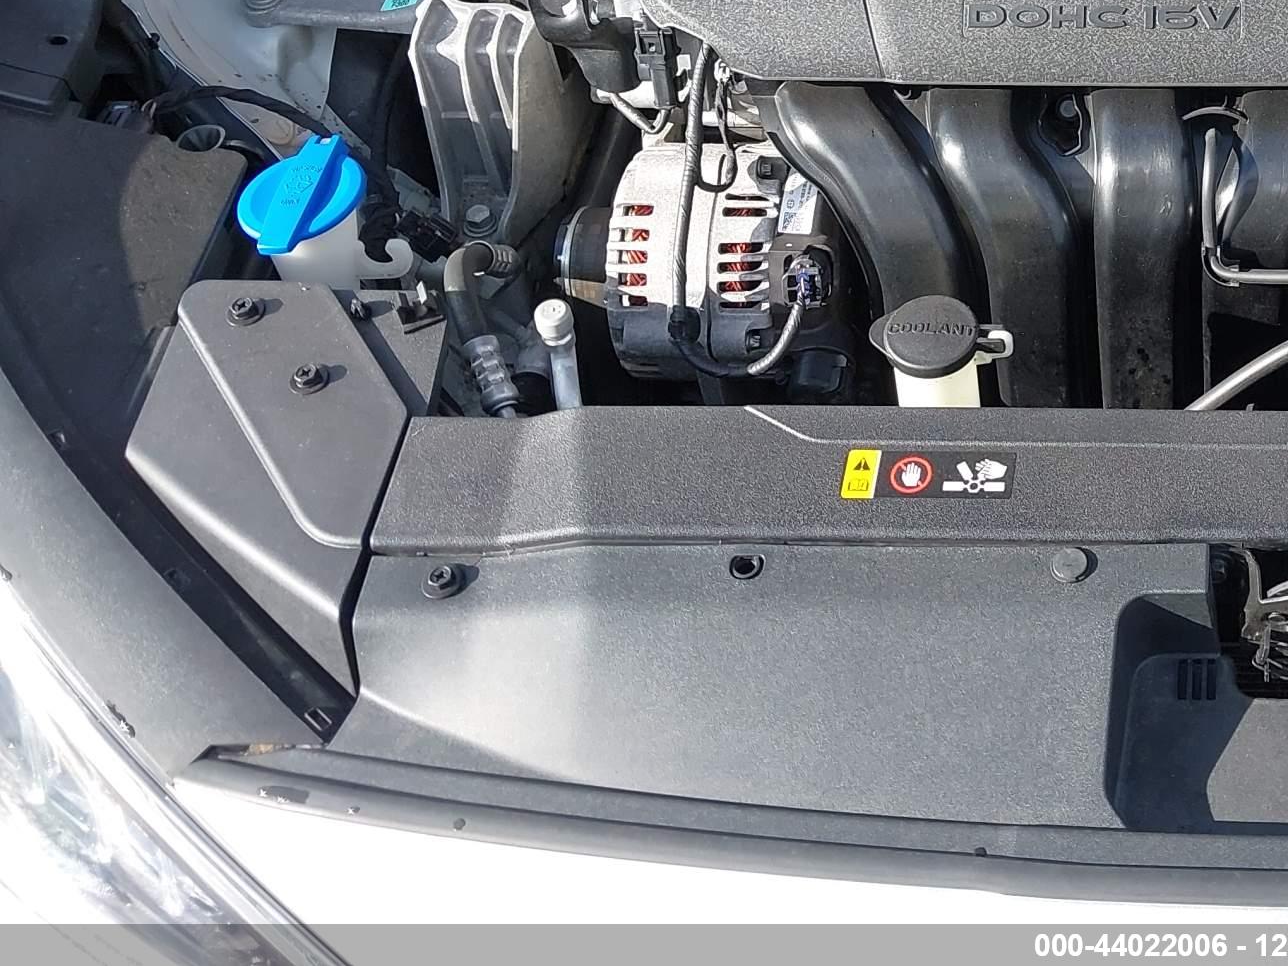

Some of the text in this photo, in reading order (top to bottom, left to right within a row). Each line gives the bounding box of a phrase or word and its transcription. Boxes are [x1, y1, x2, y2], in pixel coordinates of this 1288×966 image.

[964, 4, 1241, 31] DOHC 16V
[887, 321, 975, 337] COOLANT
